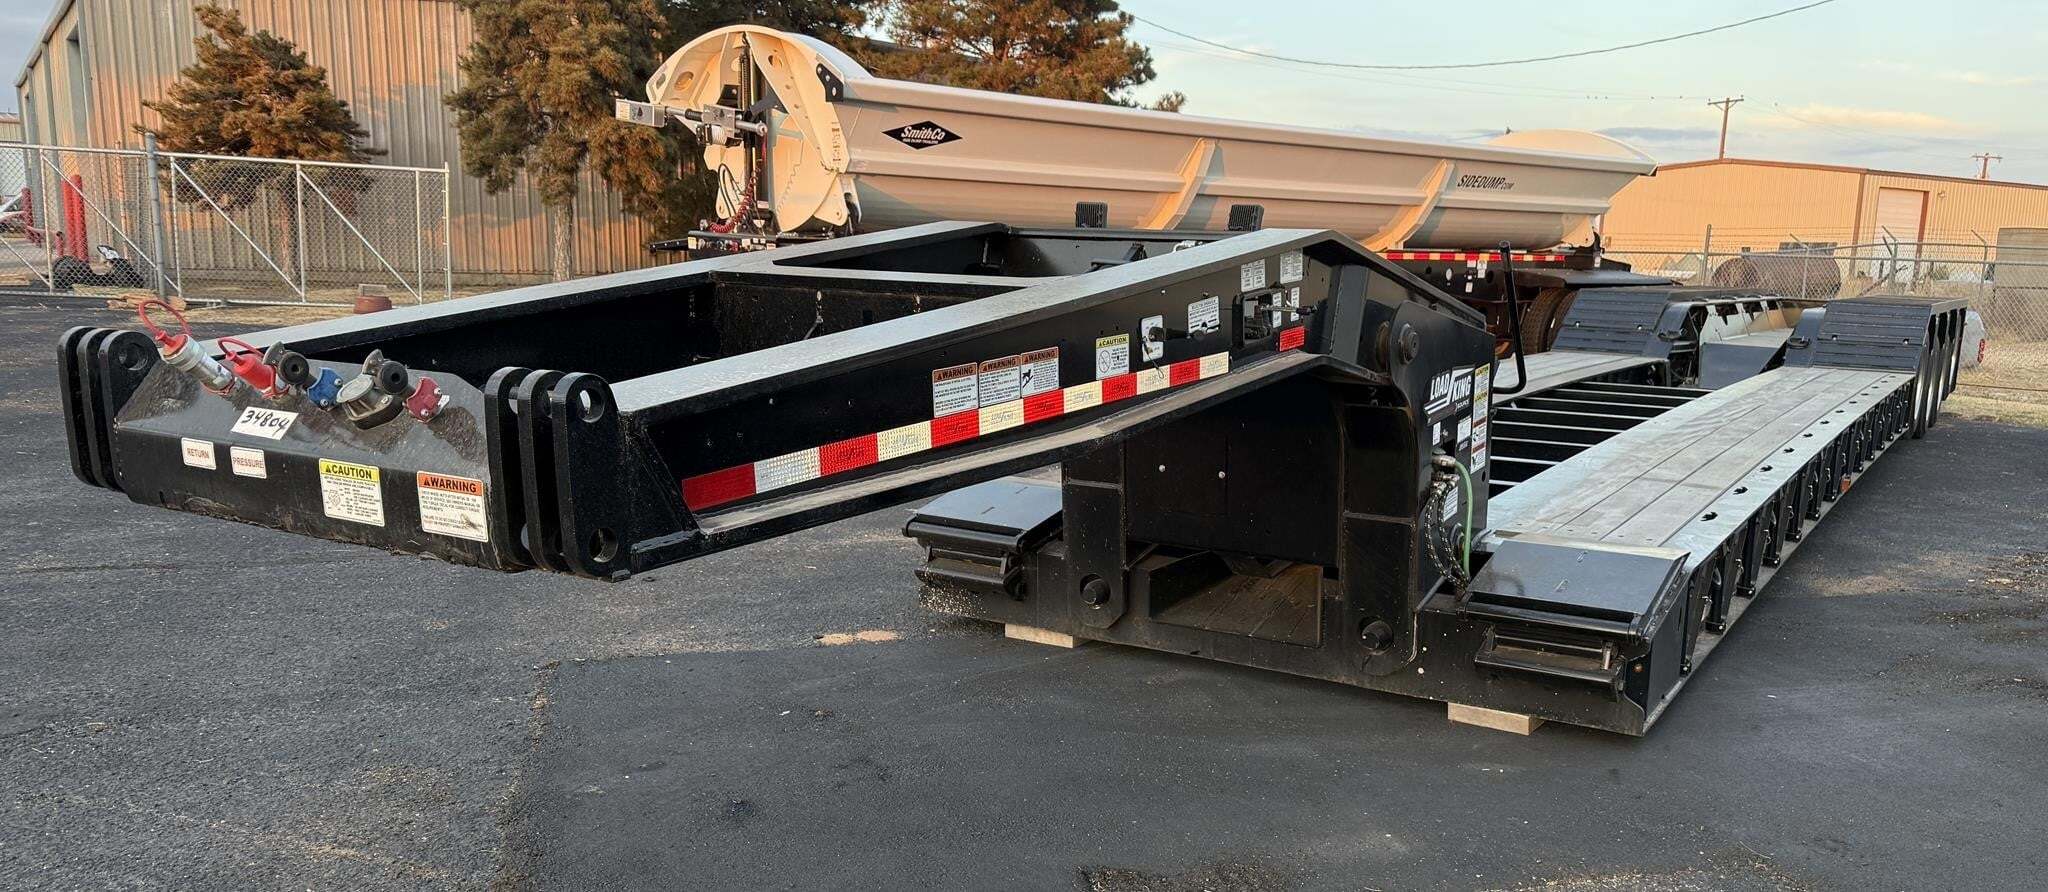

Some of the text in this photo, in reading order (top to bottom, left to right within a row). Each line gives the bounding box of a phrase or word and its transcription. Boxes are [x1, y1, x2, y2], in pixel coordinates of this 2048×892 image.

[901, 126, 946, 140] SmithCo
[1102, 336, 1127, 346] CAUTION
[1028, 350, 1056, 363] WARNING
[987, 358, 1017, 371] WARNING
[942, 366, 974, 379] WARNING
[1430, 374, 1450, 399] LOAD
[1452, 376, 1471, 401] KING
[241, 410, 289, 437] 34804
[186, 447, 209, 459] RETURN
[232, 456, 265, 469] PRESSURE
[331, 464, 372, 479] CAUTION
[430, 476, 477, 493] WARNING
